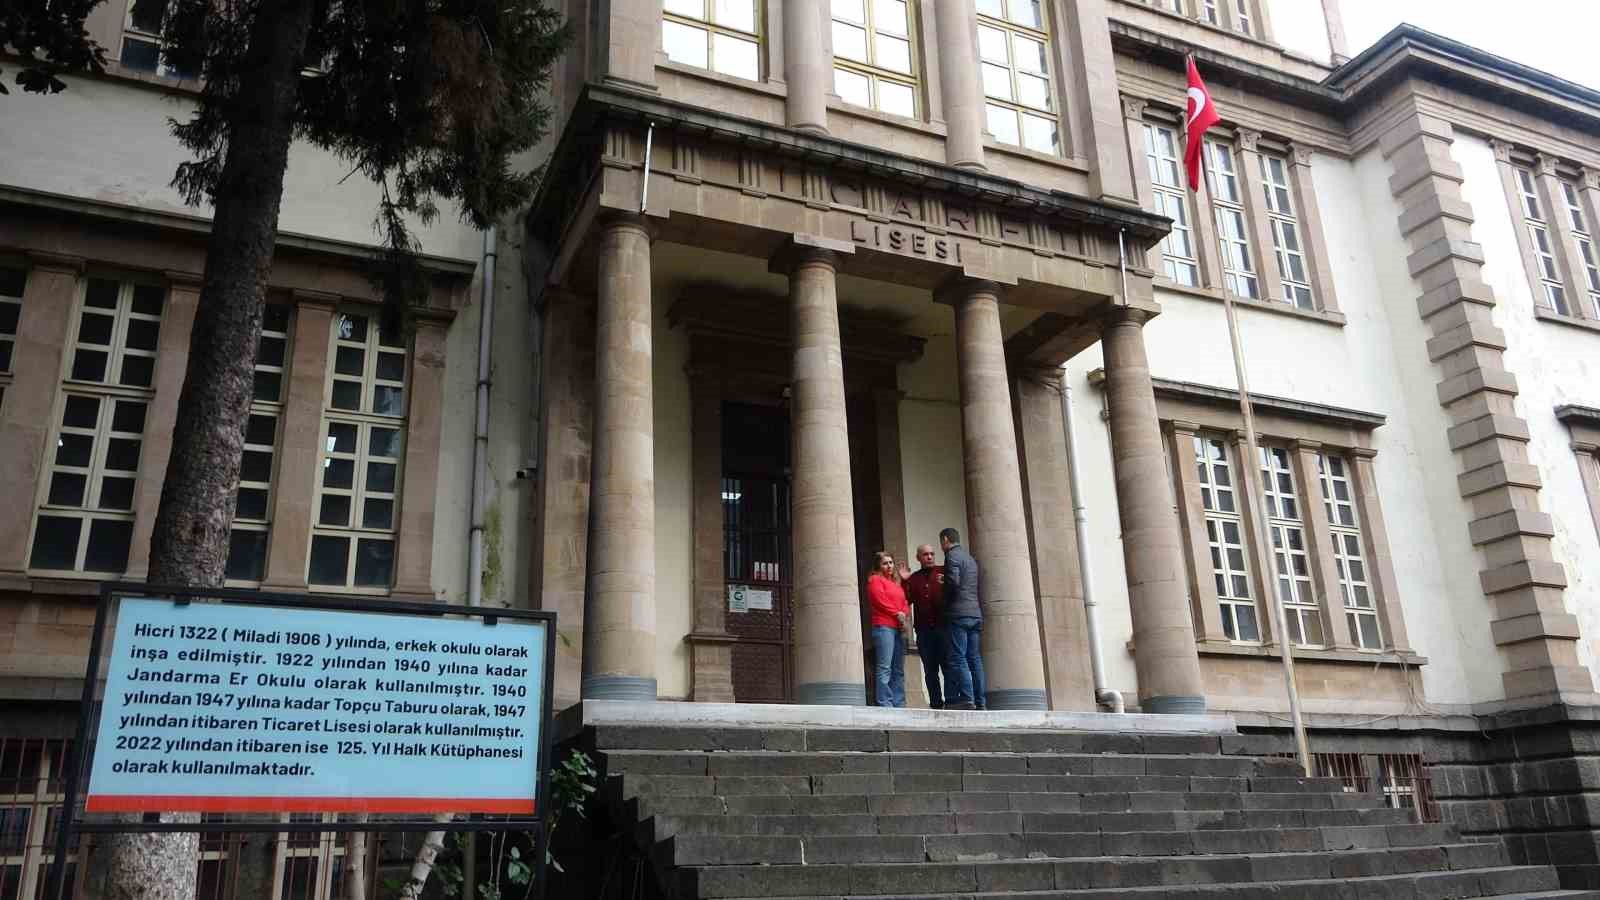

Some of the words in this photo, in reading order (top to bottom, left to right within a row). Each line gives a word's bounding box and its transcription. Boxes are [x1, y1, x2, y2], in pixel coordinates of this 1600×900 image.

[135, 624, 174, 638] Hicri
[180, 625, 217, 640] 1322
[221, 627, 228, 642] (
[233, 629, 280, 645] Miladi
[285, 632, 320, 646] 1906
[326, 634, 332, 648] )
[335, 635, 390, 651] yılında,
[395, 639, 437, 653] erkek
[441, 641, 481, 656] okulu
[484, 645, 528, 658] olarak
[130, 645, 168, 662] inşa
[177, 647, 267, 667] edilmiştir.
[276, 652, 313, 667] 1922
[322, 656, 386, 671] yılından
[394, 658, 430, 673] 1940
[438, 661, 478, 676] yılına
[486, 664, 528, 678] kadar
[127, 668, 220, 685] Jandarma
[229, 672, 248, 686] Er
[256, 673, 306, 688] Okulu
[314, 676, 367, 691] olarak
[375, 678, 485, 697] kullanılmıştır.
[492, 684, 526, 697] 1940
[122, 690, 192, 707] yılından
[195, 692, 234, 707] 1947
[236, 695, 281, 711] yılına
[283, 697, 330, 711] kadar
[334, 698, 381, 715] Topçu
[385, 699, 437, 715] Taburu
[440, 704, 490, 718] olarak,
[493, 704, 525, 718] 1947
[119, 713, 188, 730] yılından
[191, 714, 258, 731] itibaren
[262, 717, 321, 733] Ticaret
[324, 719, 371, 734] Lisesi
[374, 721, 422, 735] olarak
[425, 722, 524, 740] kullanılmıştır.
[115, 735, 162, 751] 2022
[164, 737, 233, 754] yılından
[236, 738, 301, 754] itibaren
[304, 740, 329, 754] ise
[336, 741, 367, 755] 125.
[371, 741, 390, 756] Yıl
[394, 743, 427, 757] Halk
[430, 743, 523, 760] Kütüphanesi
[112, 759, 171, 774] olarak
[172, 760, 315, 776] kullanılmaktadır.
